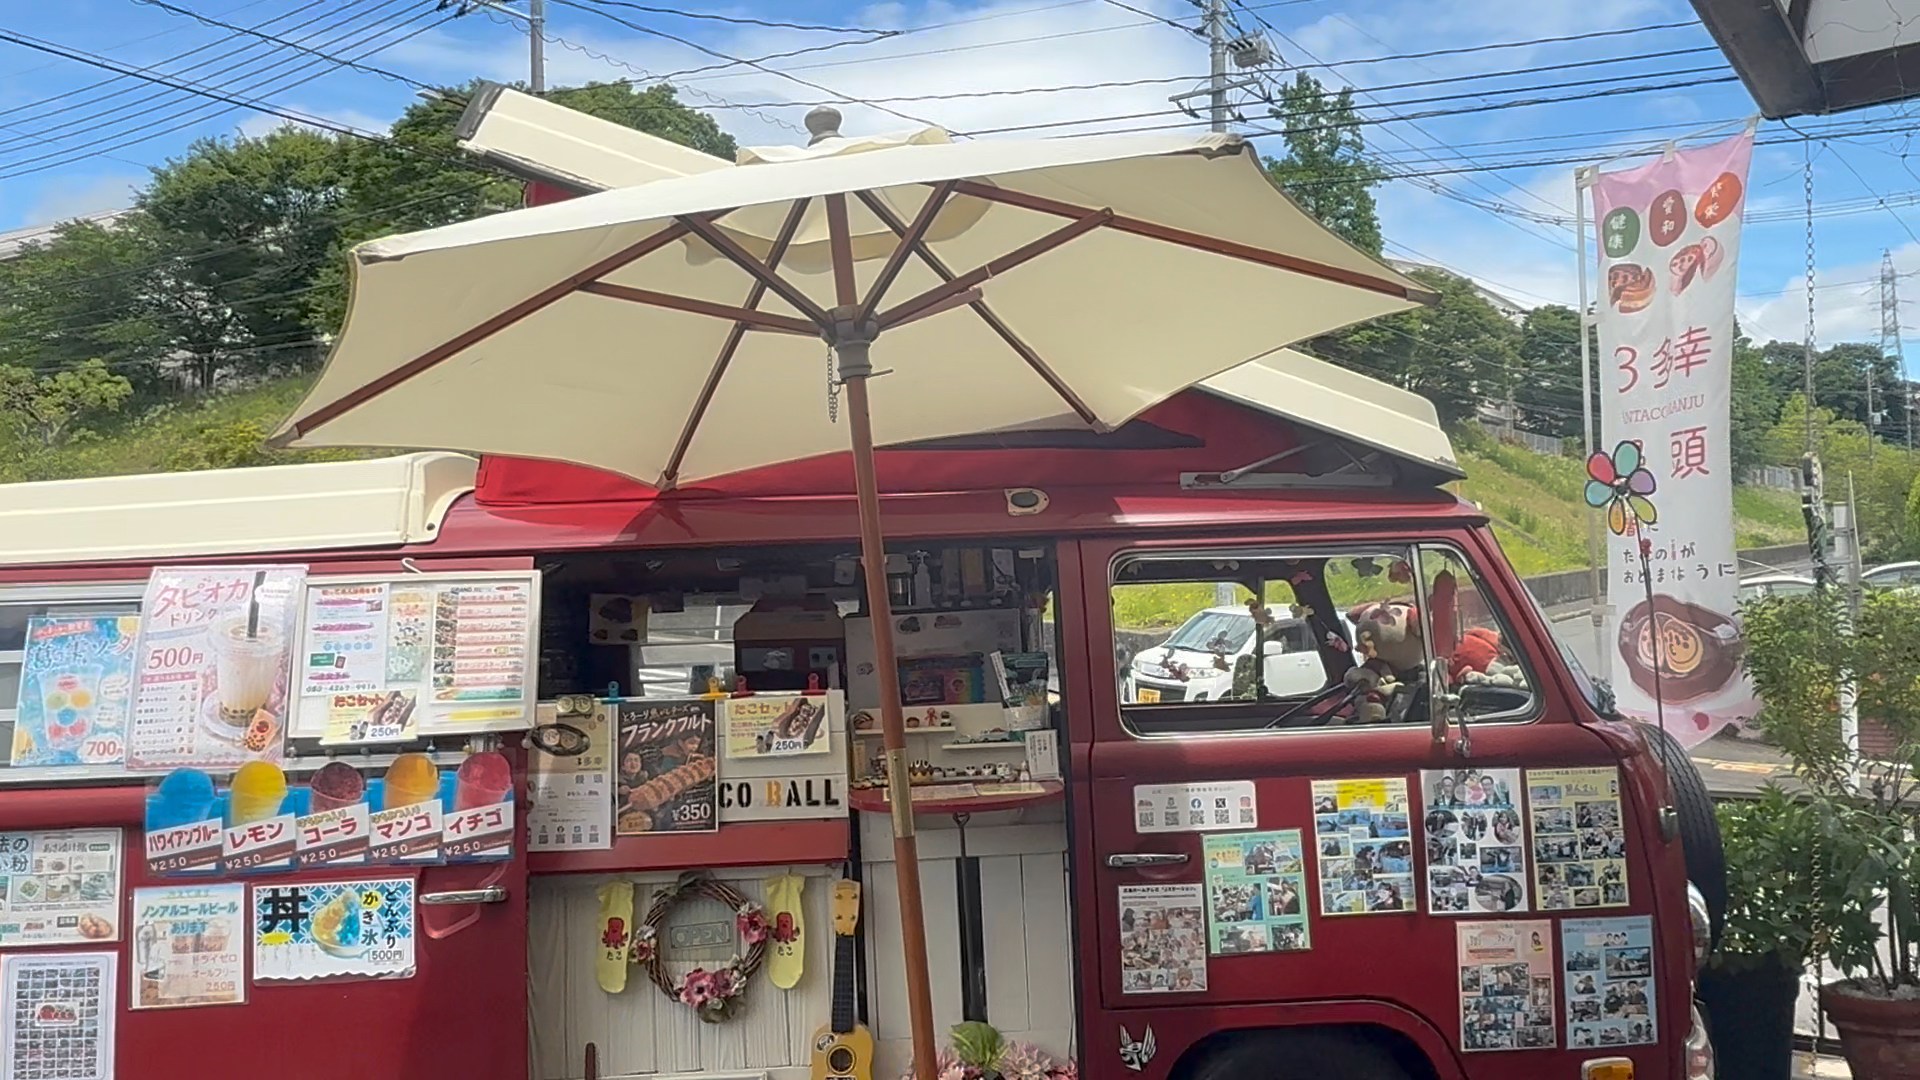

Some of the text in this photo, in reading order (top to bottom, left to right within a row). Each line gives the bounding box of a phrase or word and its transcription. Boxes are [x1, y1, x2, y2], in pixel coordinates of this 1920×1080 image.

[153, 578, 249, 618] タピオカ
[170, 609, 218, 627] ドリンク
[148, 647, 203, 670] 500円
[334, 693, 385, 707] たこセット
[621, 713, 712, 747] フランクフルト
[766, 779, 839, 808] BALL
[449, 807, 503, 834] イチゴ
[671, 802, 711, 821] ¥350
[229, 822, 284, 849] レモン
[303, 817, 357, 845] コーラ
[377, 811, 432, 839] マンゴ
[149, 825, 219, 851] ハワイアンブルー
[445, 841, 480, 857] ¥250
[225, 854, 262, 870] ¥250
[300, 849, 336, 864] ¥250
[372, 844, 408, 859] ¥250
[150, 856, 187, 872] ¥250
[141, 901, 238, 918] ノンアルコールビール
[262, 887, 309, 933] 丼
[361, 892, 378, 946] かき氷
[384, 887, 401, 950] どんぶり
[171, 921, 208, 935] あります
[674, 924, 729, 947] OPEN
[372, 950, 403, 961] 500円
[191, 968, 238, 978] オールフリー
